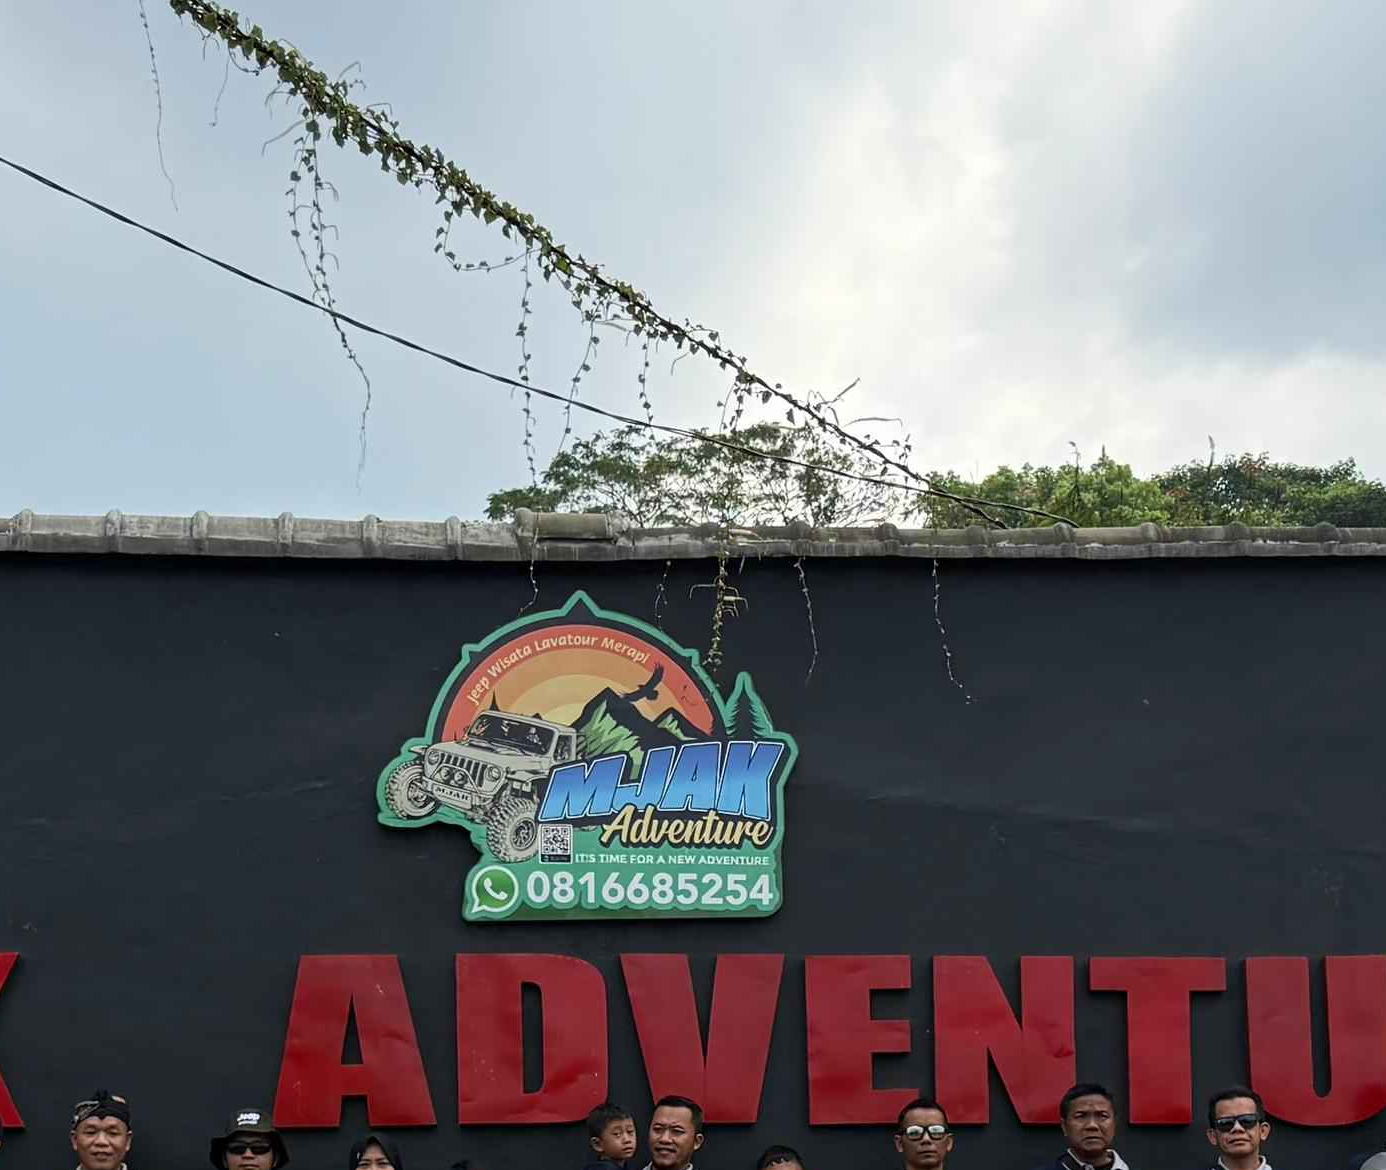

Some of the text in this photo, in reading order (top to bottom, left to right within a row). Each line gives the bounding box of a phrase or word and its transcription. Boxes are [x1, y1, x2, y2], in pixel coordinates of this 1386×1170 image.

[467, 634, 651, 706] Jeep Wisata Lavatour Merapi
[539, 740, 784, 821] MJAK
[600, 809, 774, 846] Adventure
[599, 854, 628, 864] TIME
[630, 855, 654, 864] FOR
[656, 855, 666, 864] A
[668, 855, 696, 865] NEW
[698, 856, 770, 866] ADVENTURE
[526, 871, 773, 905] 0816685254
